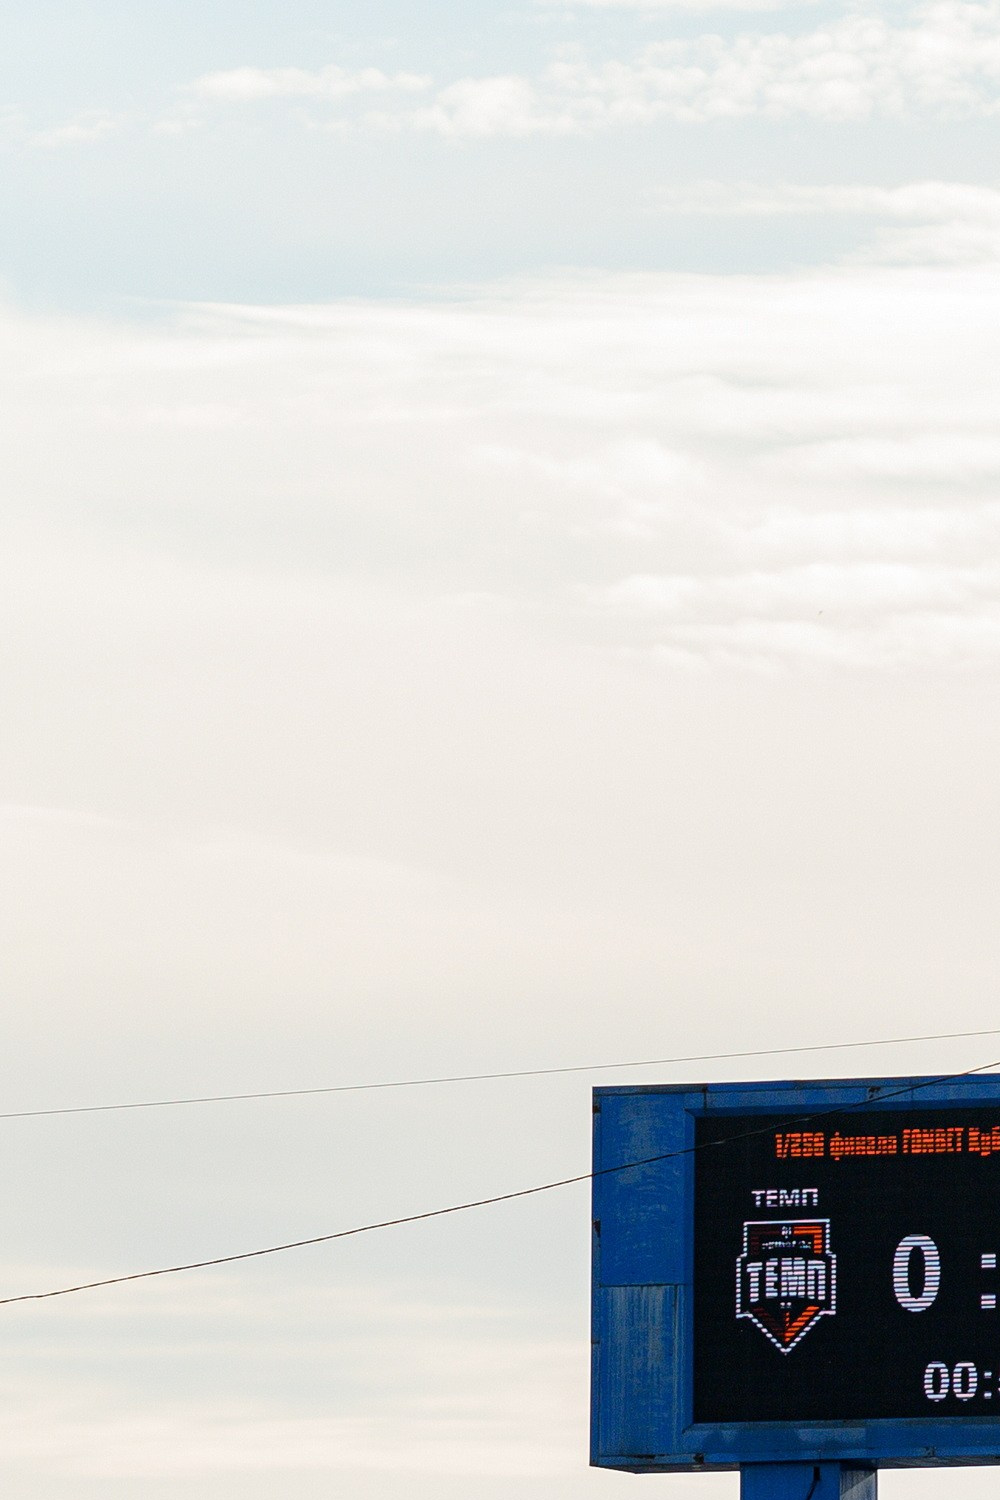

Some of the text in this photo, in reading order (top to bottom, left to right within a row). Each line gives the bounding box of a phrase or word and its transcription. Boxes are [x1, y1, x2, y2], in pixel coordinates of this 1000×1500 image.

[830, 1131, 897, 1161] финала
[751, 1188, 819, 1207] ТЕМП
[746, 1257, 826, 1302] ТЕМП
[892, 1233, 941, 1312] 0
